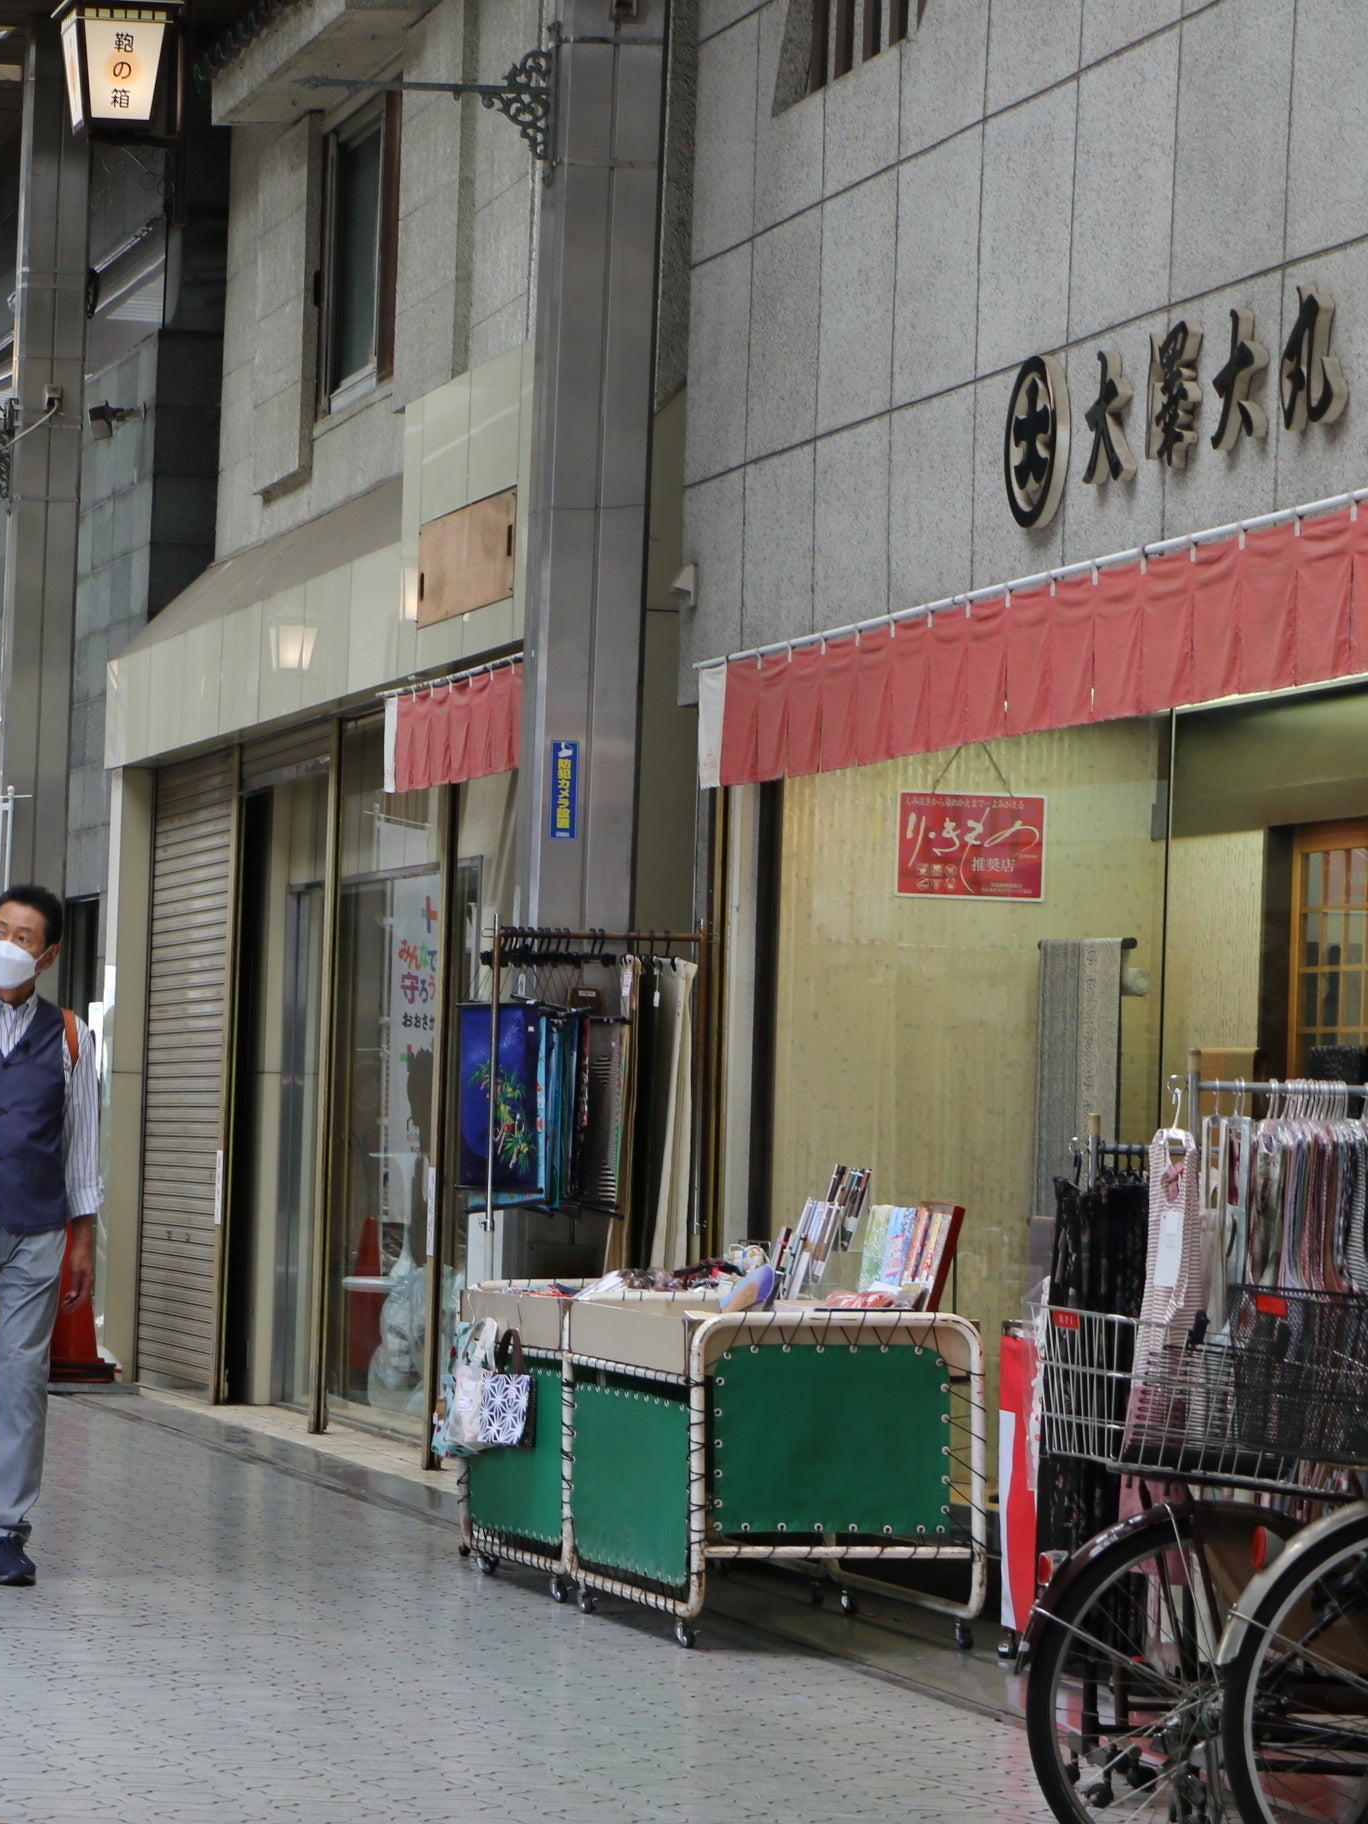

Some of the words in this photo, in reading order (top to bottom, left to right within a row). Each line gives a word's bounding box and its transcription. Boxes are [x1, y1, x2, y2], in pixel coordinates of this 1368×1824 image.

[110, 31, 135, 109] 鞄の箱
[556, 758, 572, 829] 防犯カメラ設置
[971, 857, 1016, 873] 推奨店
